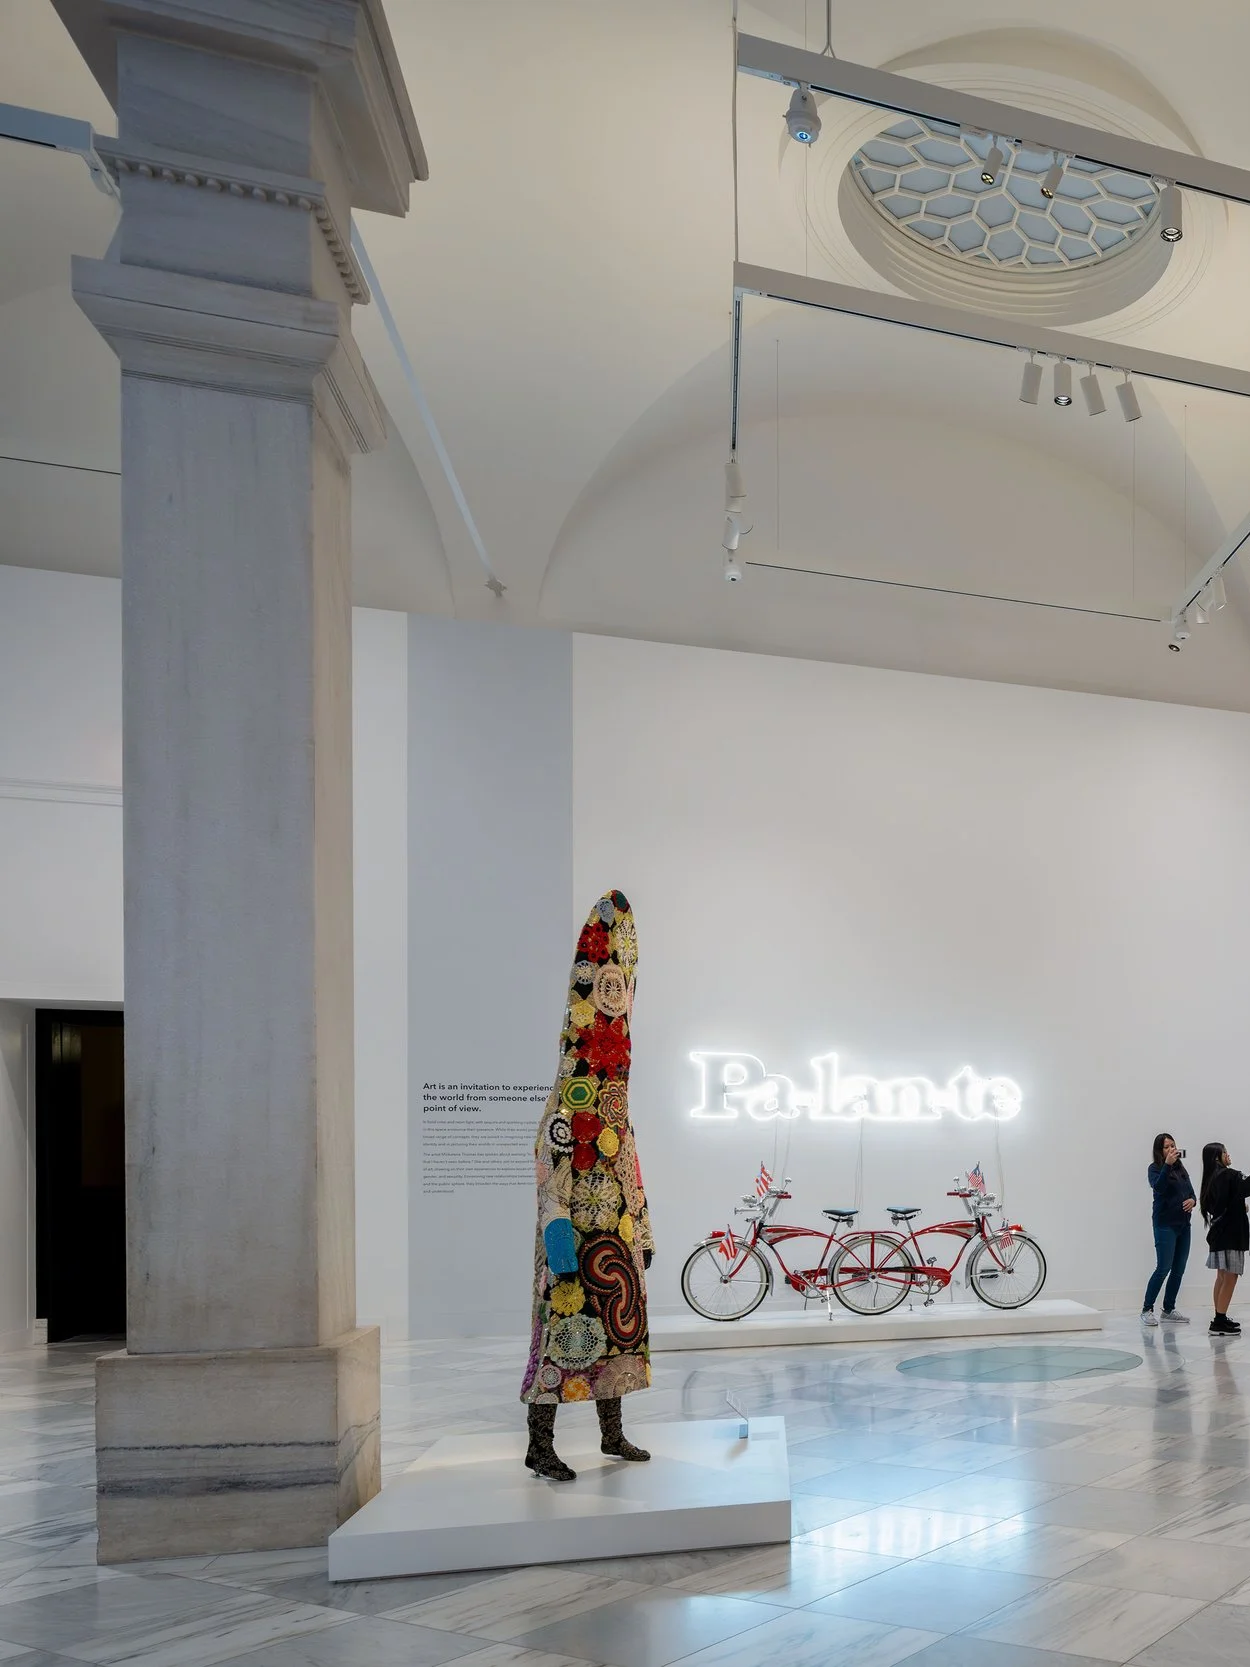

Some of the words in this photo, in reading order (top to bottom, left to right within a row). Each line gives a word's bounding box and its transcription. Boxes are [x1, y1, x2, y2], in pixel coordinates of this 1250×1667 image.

[460, 1083, 500, 1091] invitation
[513, 1084, 553, 1093] experienc
[423, 1105, 446, 1113] point
